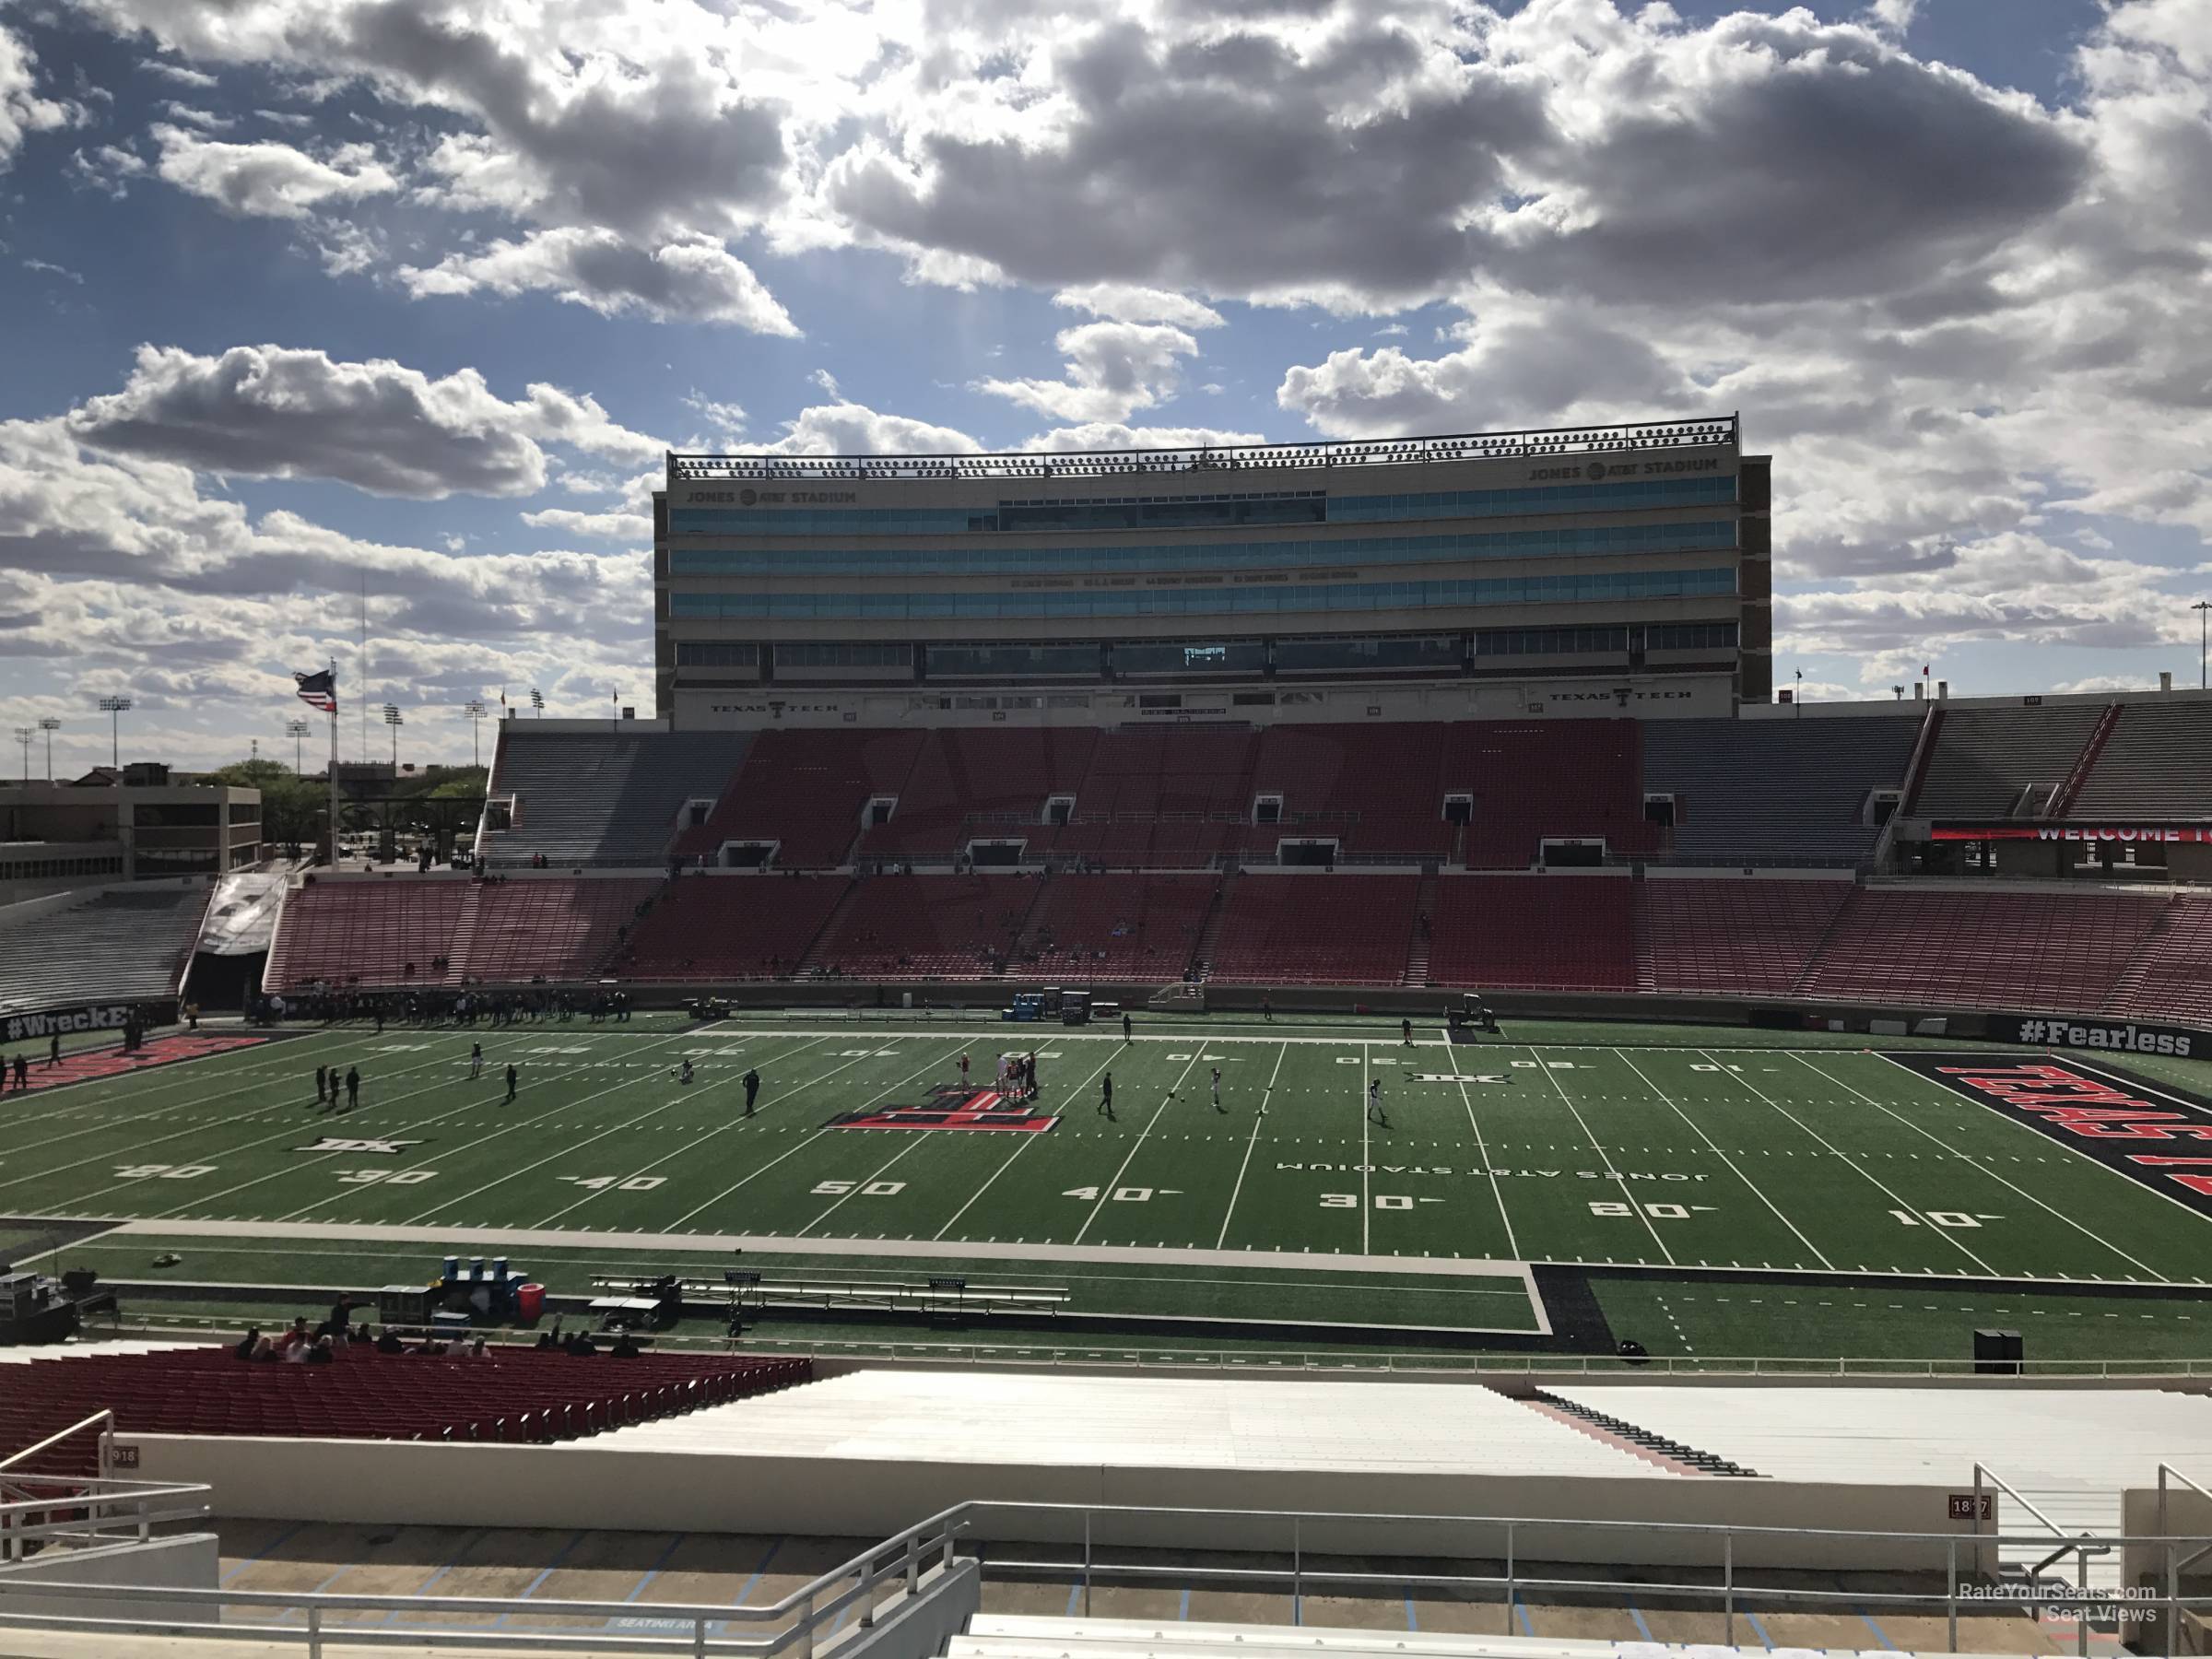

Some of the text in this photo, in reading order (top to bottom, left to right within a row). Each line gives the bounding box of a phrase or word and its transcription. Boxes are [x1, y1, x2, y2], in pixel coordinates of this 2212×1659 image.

[1528, 458, 1718, 481] JONES AT&T STADIUM
[686, 491, 735, 503] JONES
[791, 492, 856, 503] STADIUM
[1549, 692, 1611, 700] TEXAS
[1634, 691, 1692, 700] TECH
[2037, 827, 2181, 841] WELCOME
[7, 1006, 135, 1040] #WreckE
[2019, 1019, 2192, 1056] #Fearless
[1935, 1064, 2212, 1140] TEXAS
[112, 1164, 219, 1179] 20
[336, 1170, 441, 1184] 30
[1276, 1162, 1711, 1182] JONES AT&T STADIUM
[573, 1176, 668, 1189] 40
[810, 1181, 908, 1195] 50
[1061, 1186, 1154, 1202] 40
[1319, 1194, 1415, 1210] 30
[1587, 1202, 1691, 1218] 20
[1888, 1210, 1983, 1228] 10
[676, 1619, 712, 1630] ARA
